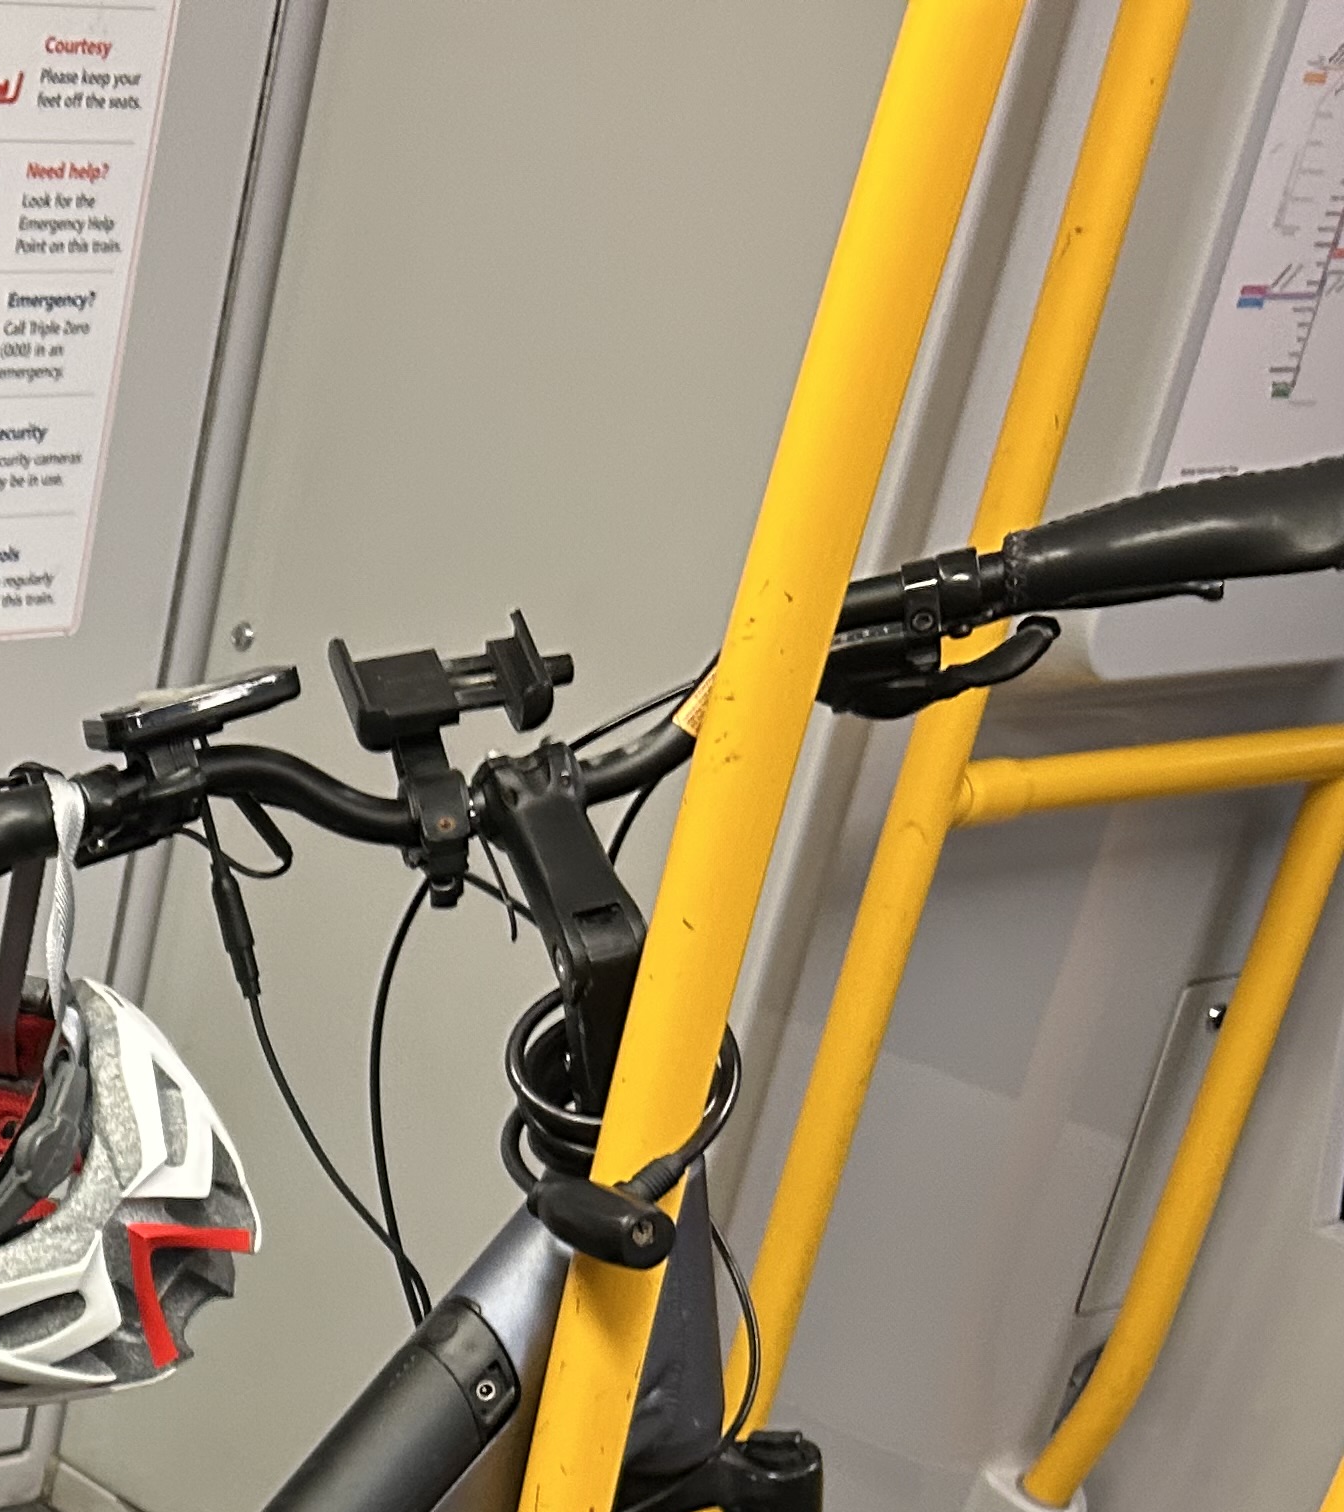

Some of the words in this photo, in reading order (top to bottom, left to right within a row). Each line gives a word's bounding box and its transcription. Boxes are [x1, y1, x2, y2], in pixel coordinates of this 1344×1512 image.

[45, 36, 112, 60] Courtesy
[39, 68, 78, 86] Please
[81, 69, 110, 88] keep
[113, 73, 141, 88] your
[36, 92, 62, 108] feet
[64, 93, 83, 108] off
[86, 94, 105, 108] the
[108, 96, 142, 110] seats.
[26, 162, 65, 180] Need
[69, 162, 110, 184] help?
[21, 192, 51, 209] Look
[54, 193, 72, 209] for
[75, 194, 95, 209] the
[18, 217, 86, 235] Emergency
[88, 217, 115, 234] Help
[15, 239, 46, 254] Point
[49, 242, 64, 254] on
[67, 239, 88, 254] this
[7, 290, 96, 312] Emergency?
[3, 319, 26, 336] Call
[29, 319, 60, 338] Triple
[63, 320, 90, 336] Zero
[0, 342, 31, 360] (000)
[34, 343, 46, 357] in
[48, 345, 64, 357] an
[33, 453, 83, 467] cameras
[10, 475, 25, 488] be
[28, 475, 39, 488] in
[3, 573, 55, 592] regularly
[1, 595, 22, 609] this
